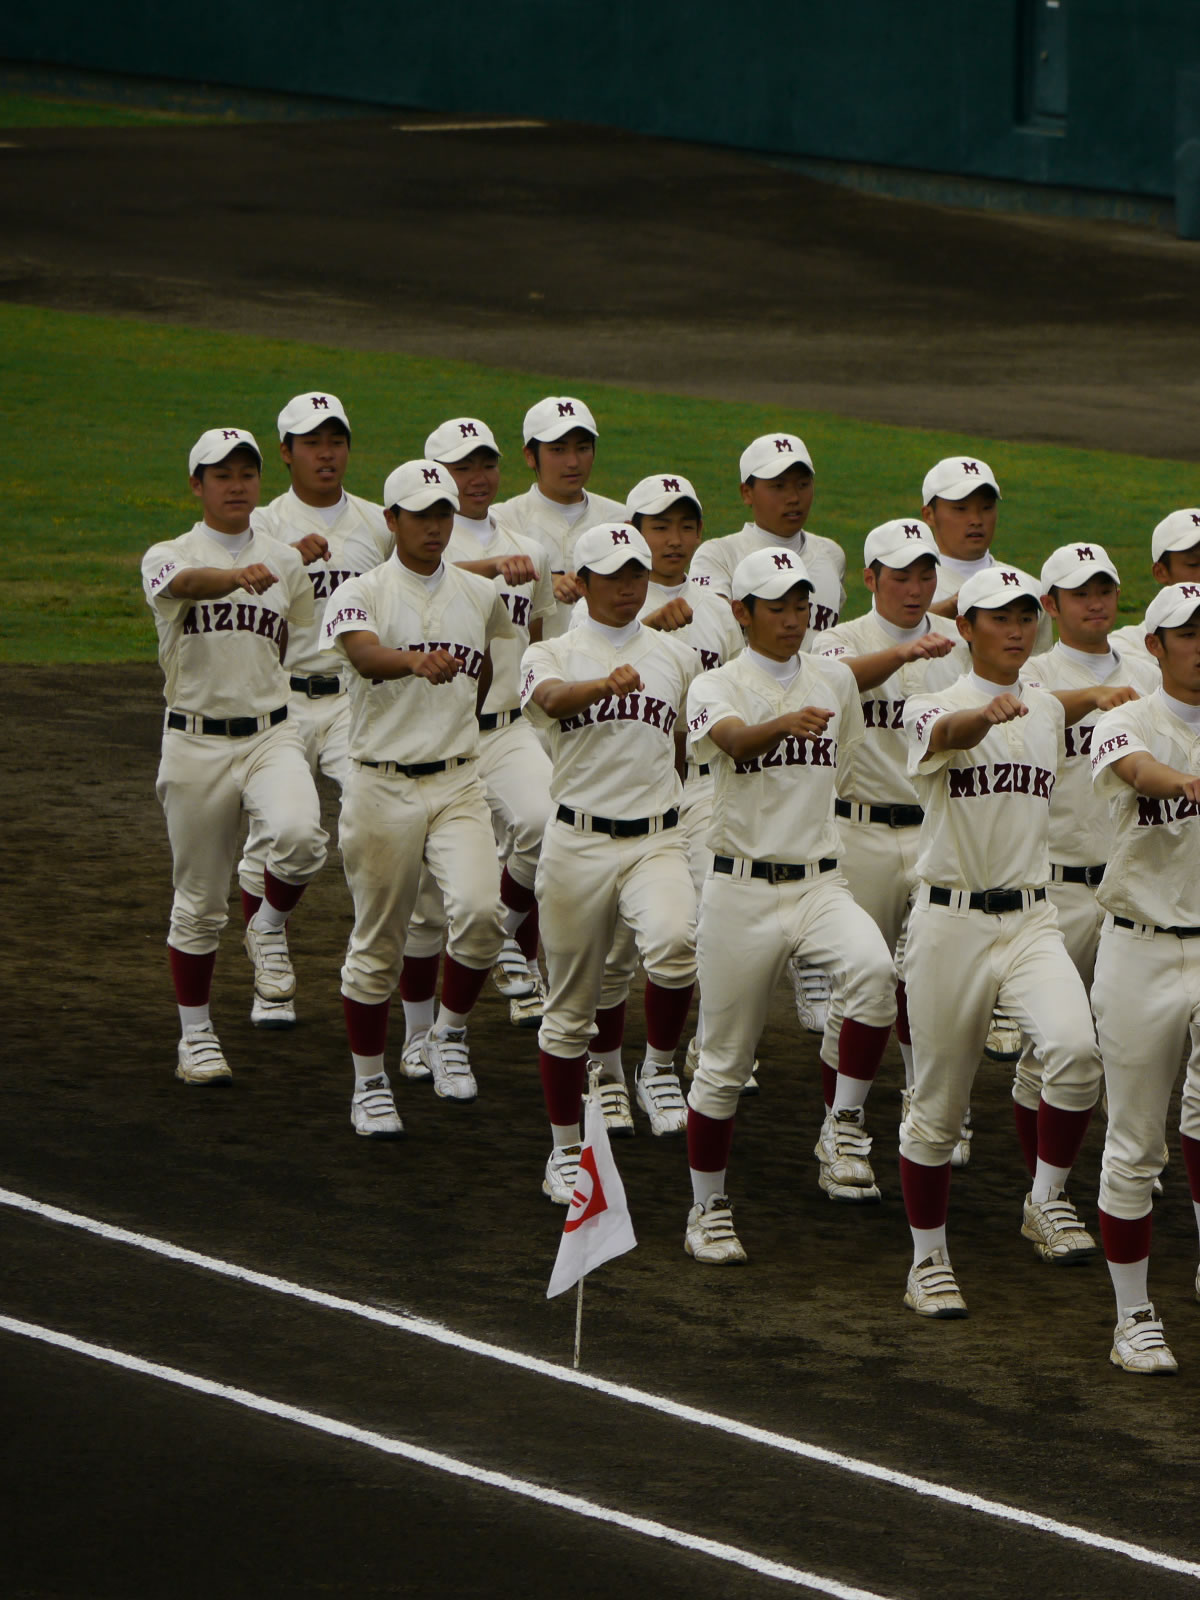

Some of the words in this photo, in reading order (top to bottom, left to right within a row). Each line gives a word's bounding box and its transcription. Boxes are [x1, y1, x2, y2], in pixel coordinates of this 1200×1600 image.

[311, 397, 330, 409] M
[557, 402, 575, 417] M
[223, 430, 240, 441] M
[459, 422, 479, 438] M
[774, 439, 794, 453] M
[421, 468, 441, 484] M
[961, 462, 981, 475] M
[661, 478, 681, 492] M
[610, 529, 631, 546] M
[903, 524, 922, 539] M
[771, 553, 794, 570] M
[1075, 547, 1096, 561] M
[1000, 572, 1021, 587] M
[948, 762, 1056, 804] MIZUK
